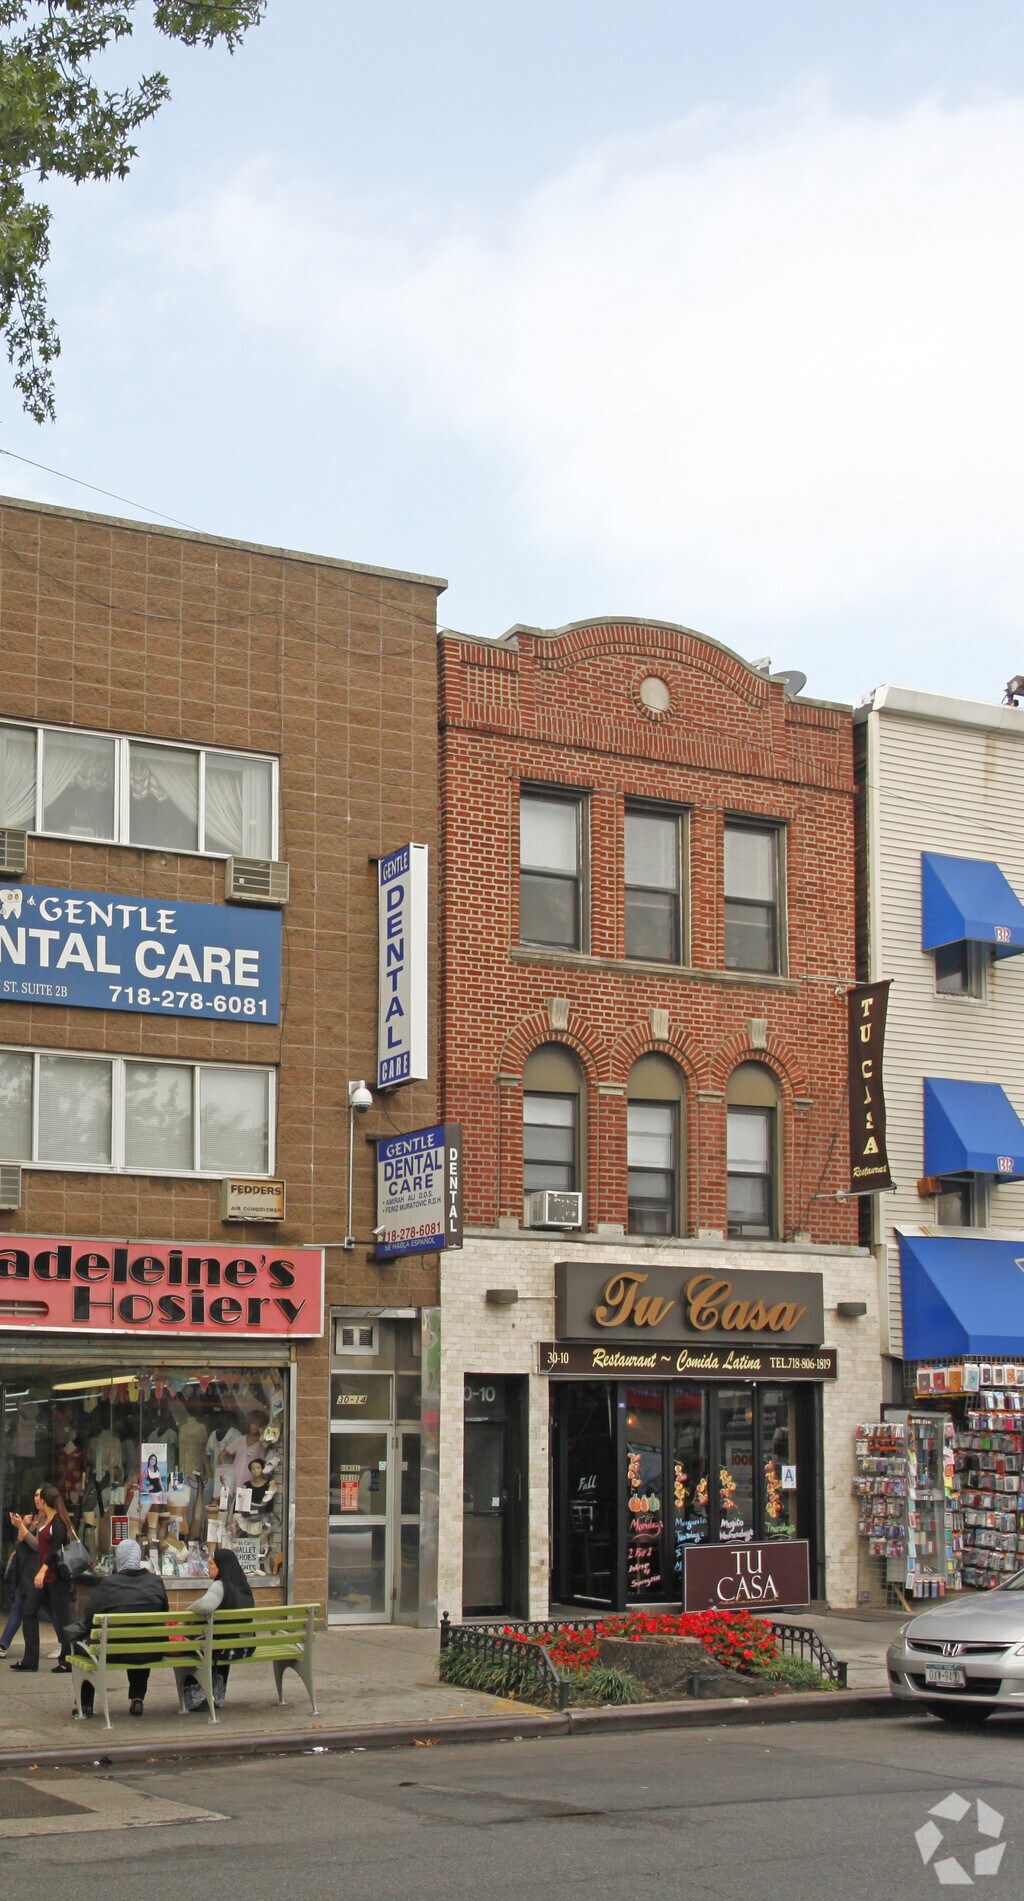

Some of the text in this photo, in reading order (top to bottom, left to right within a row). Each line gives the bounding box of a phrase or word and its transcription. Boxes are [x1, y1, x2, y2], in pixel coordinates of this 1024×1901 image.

[382, 851, 408, 881] GENTLE
[39, 897, 178, 935] GENTLE
[134, 940, 260, 988] CARE
[385, 883, 405, 1050] DENTAL
[3, 979, 20, 993] ST.
[21, 980, 53, 996] SUITE
[55, 984, 68, 998] 2B
[108, 986, 268, 1017] 718-278-6081
[860, 997, 873, 1043] TU
[382, 1053, 409, 1082] CARE
[386, 1133, 435, 1158] GENTLE
[384, 1149, 443, 1182] DENTAL
[230, 1184, 282, 1195] FEDDERS
[388, 1173, 434, 1197] CARE
[449, 1148, 458, 1233] DENTAL
[392, 1241, 410, 1249] HABLA
[72, 1285, 307, 1328] Hosiery
[593, 1271, 807, 1331] Tu Casa
[547, 1348, 831, 1372] 30-10 Restaurant Comida Latina TEL.718-806-1819
[338, 1395, 367, 1404] 30-14
[784, 1468, 794, 1482] A
[731, 1550, 763, 1575] TU
[717, 1574, 779, 1601] CASA
